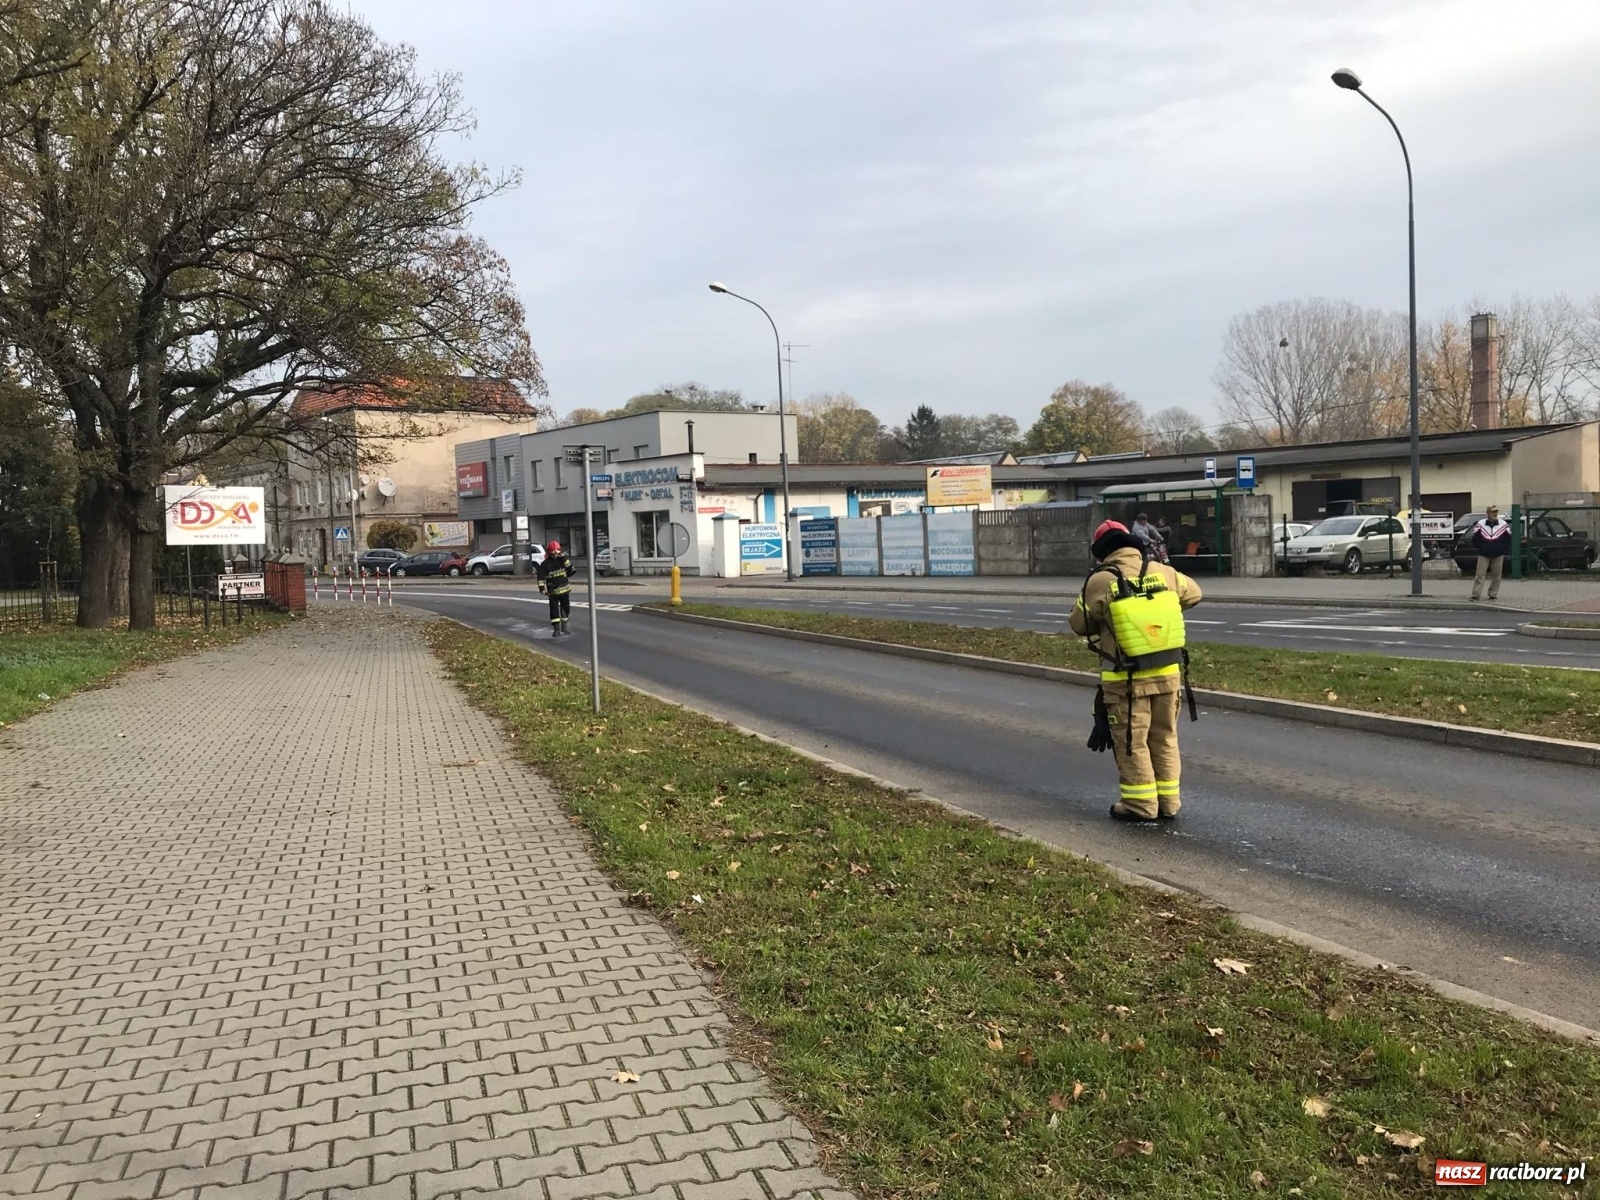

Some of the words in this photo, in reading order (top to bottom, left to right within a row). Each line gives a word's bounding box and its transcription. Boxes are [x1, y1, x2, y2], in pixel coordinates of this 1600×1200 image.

[615, 466, 678, 487] ELEKTROCOM
[440, 523, 467, 538] BHP
[931, 563, 973, 574] NARZĘDZIA
